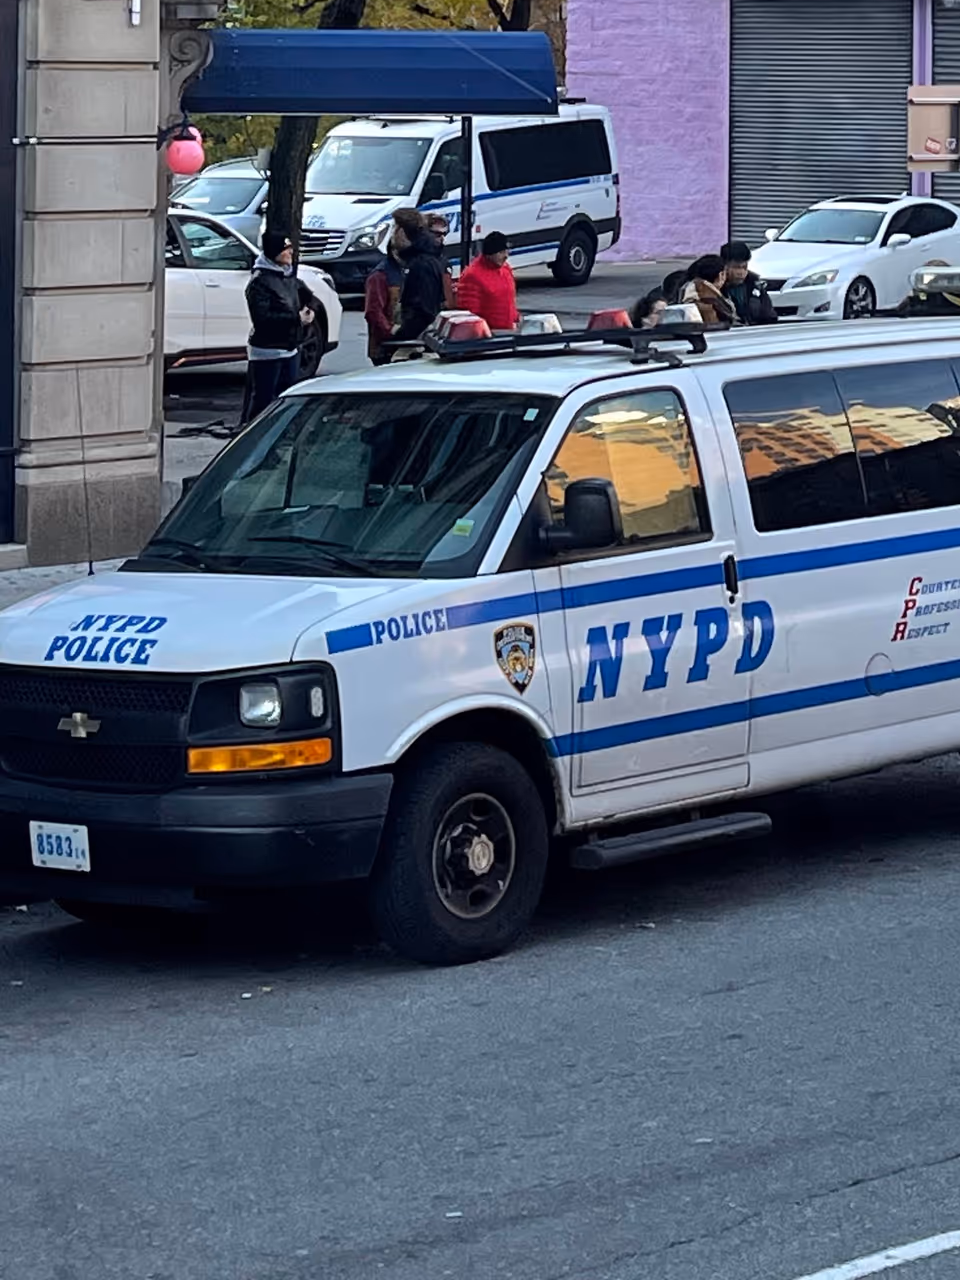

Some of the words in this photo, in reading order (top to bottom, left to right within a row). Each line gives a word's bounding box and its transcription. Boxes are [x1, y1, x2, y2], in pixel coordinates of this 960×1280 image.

[70, 614, 168, 633] NYPD
[373, 607, 446, 644] POLICE
[44, 635, 159, 665] POLICE
[577, 600, 774, 703] NYPD
[36, 833, 73, 858] 8583
